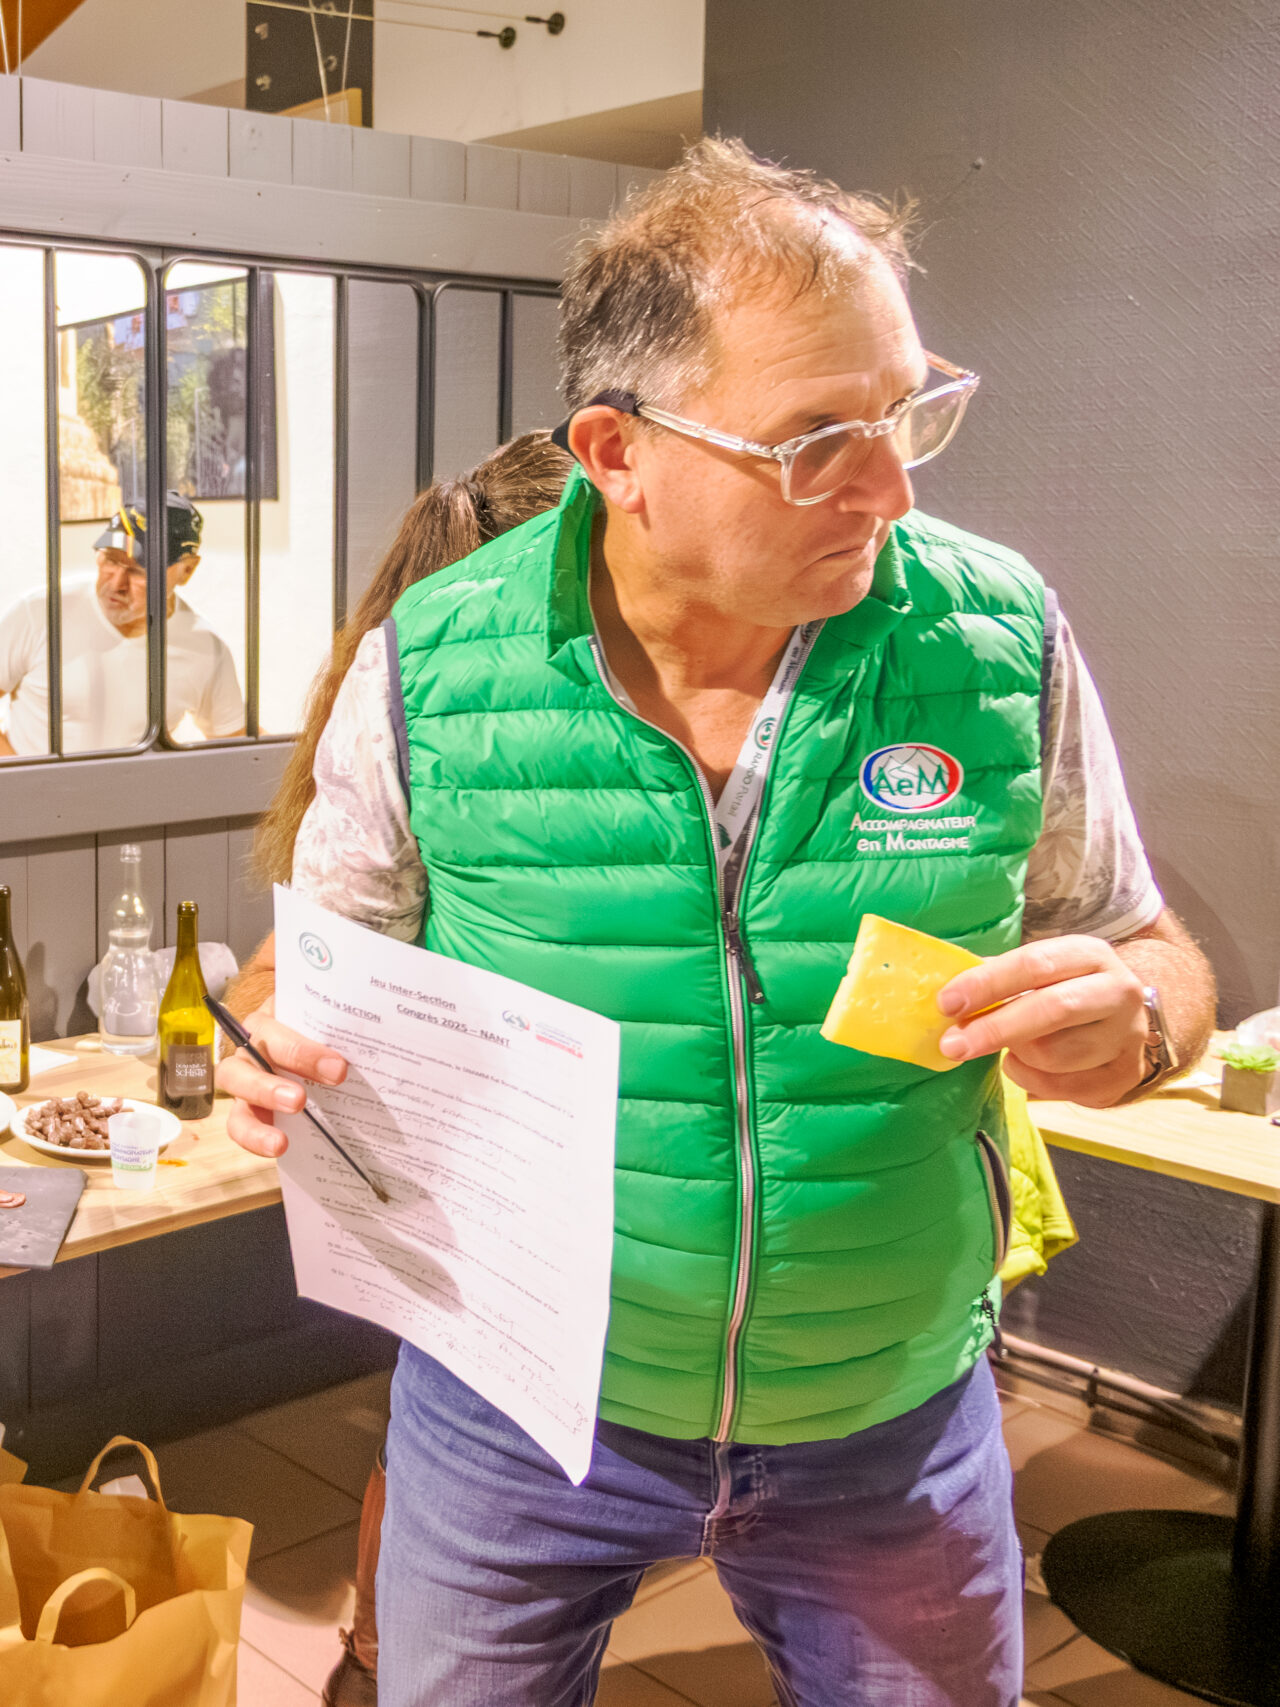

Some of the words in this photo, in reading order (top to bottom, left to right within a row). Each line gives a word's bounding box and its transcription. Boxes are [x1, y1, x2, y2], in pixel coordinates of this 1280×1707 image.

[742, 752, 763, 786] RANDO
[871, 764, 951, 797] AeM
[856, 837, 881, 852] en
[370, 976, 386, 989] Jeu
[389, 982, 457, 1010] Inter-Section
[343, 1003, 382, 1023] SECTION
[396, 1003, 439, 1025] Congrès
[441, 1017, 469, 1033] 2025
[480, 1029, 511, 1047] NANT
